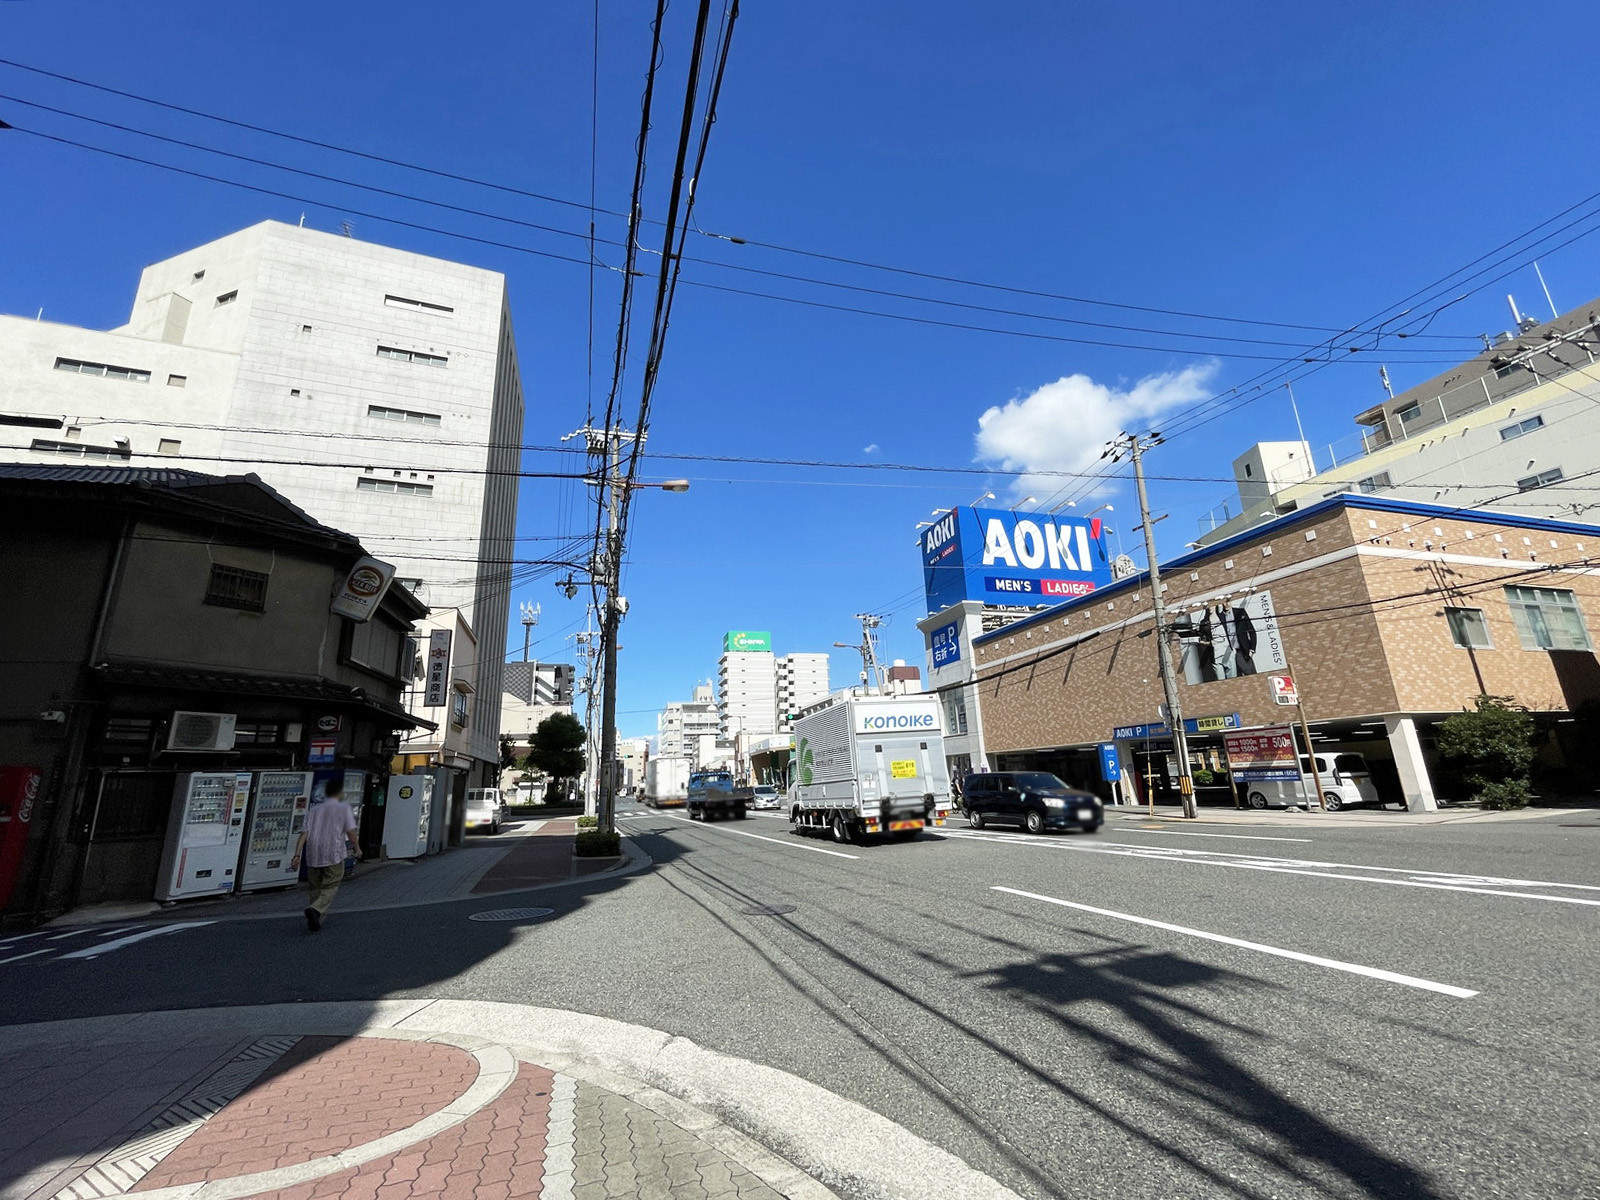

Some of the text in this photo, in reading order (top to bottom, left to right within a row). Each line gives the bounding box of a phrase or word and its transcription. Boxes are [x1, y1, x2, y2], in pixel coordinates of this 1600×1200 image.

[926, 514, 955, 554] AOKI
[982, 518, 1093, 572] AOKI
[995, 579, 1090, 595] MEN'S LADIES'
[947, 626, 955, 643] P
[1273, 677, 1285, 695] P
[1198, 716, 1233, 727] 時間貸し P
[1116, 728, 1133, 738] AOKI
[1136, 726, 1142, 736] P
[1108, 760, 1115, 770] P
